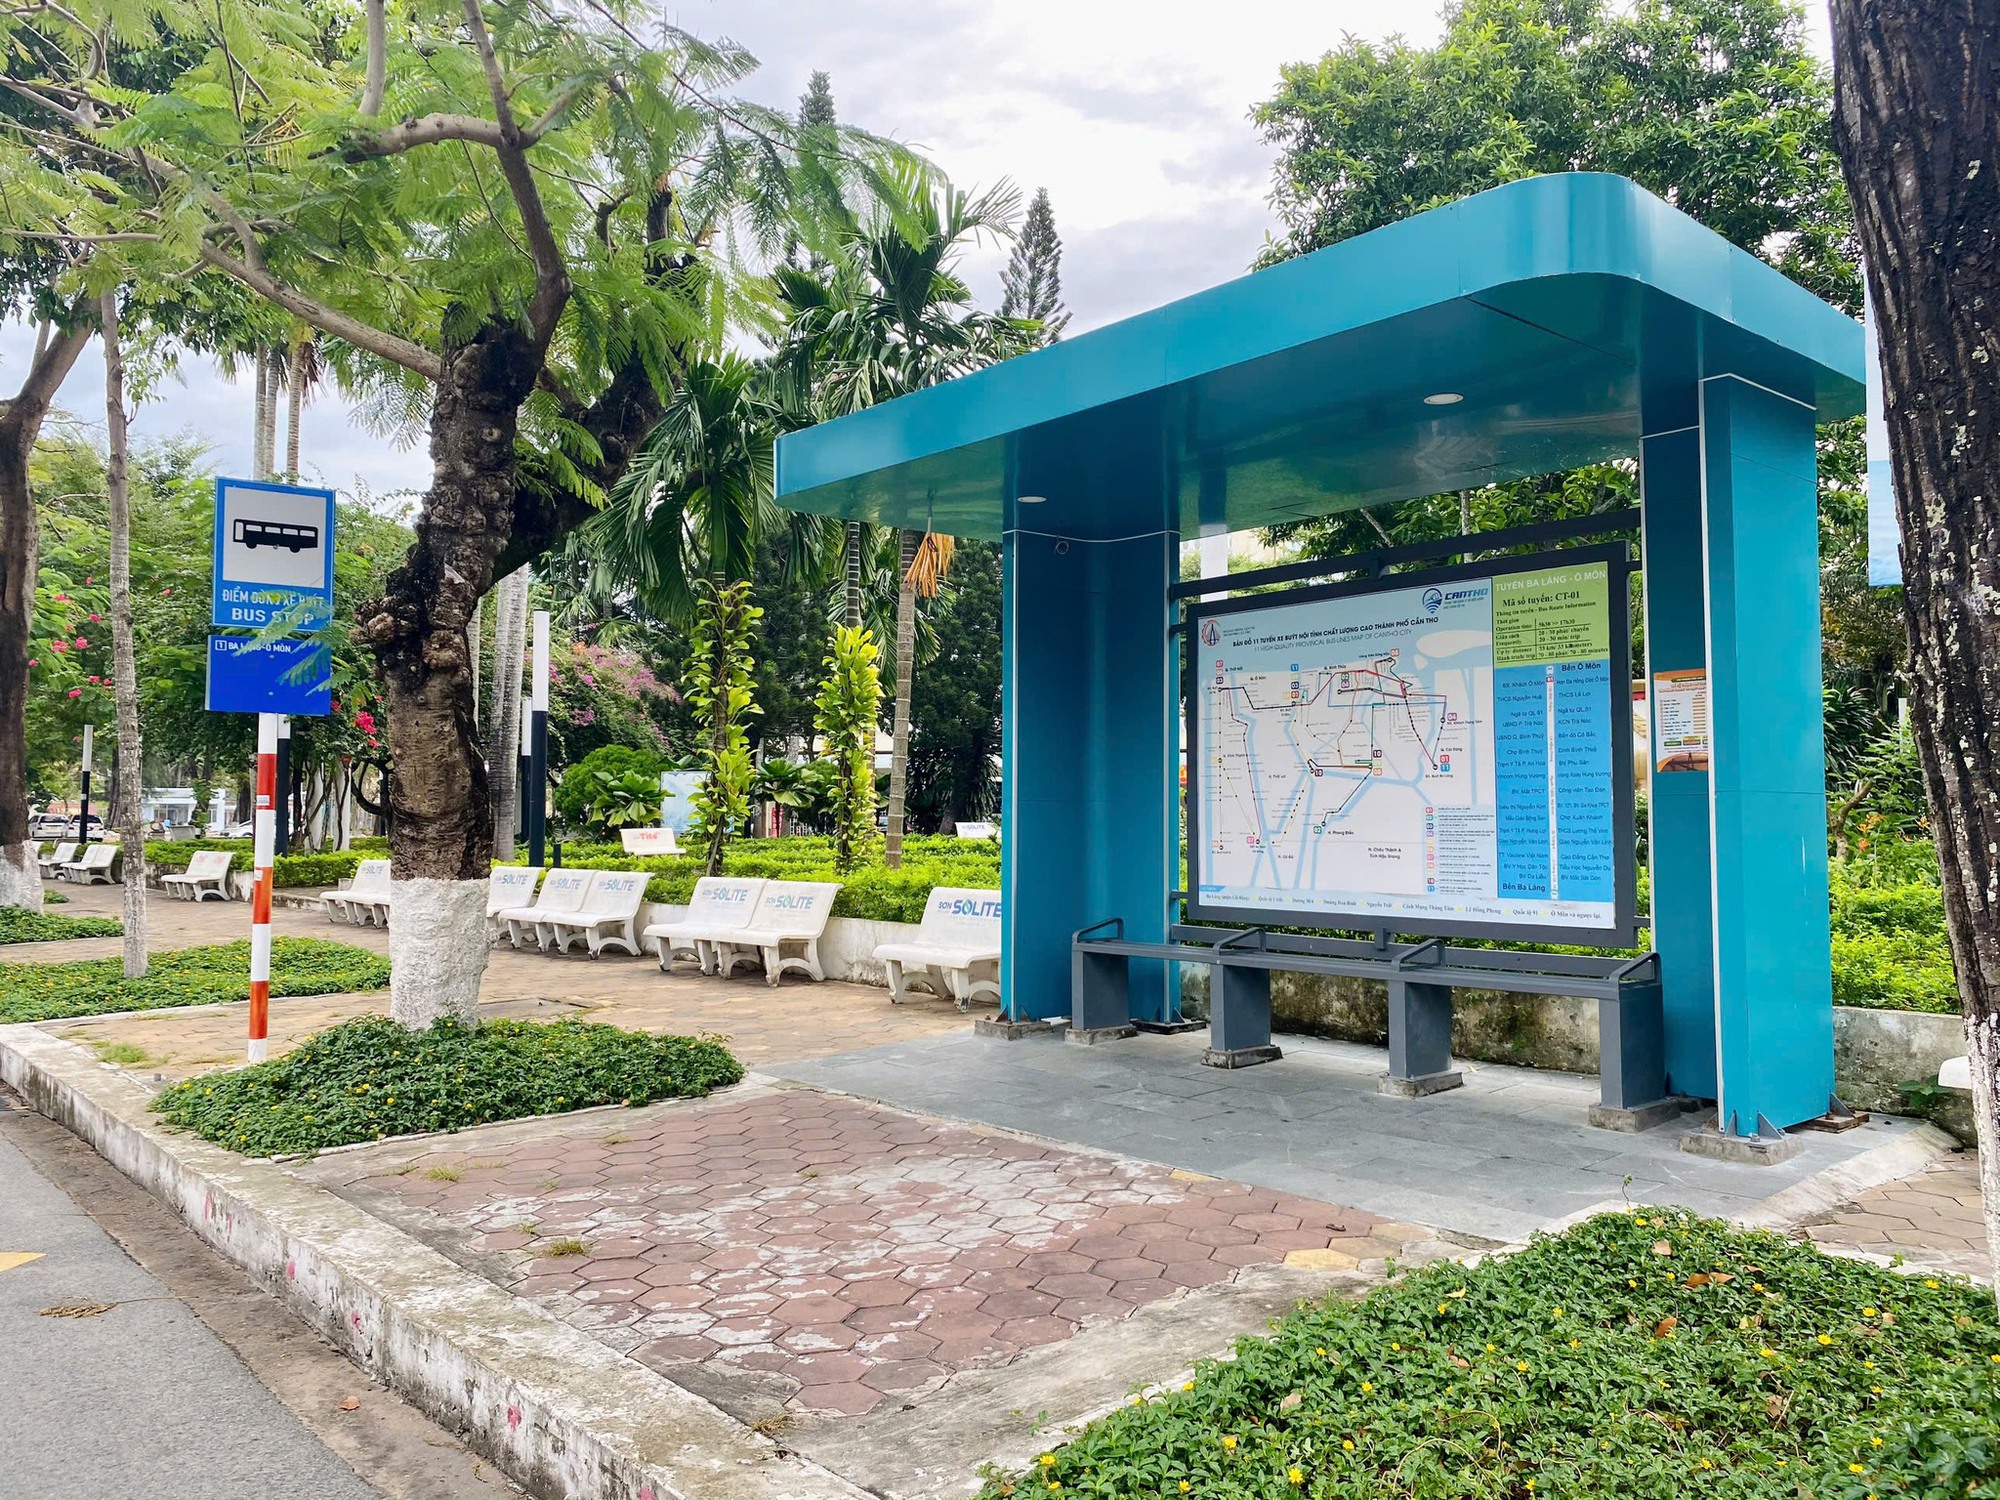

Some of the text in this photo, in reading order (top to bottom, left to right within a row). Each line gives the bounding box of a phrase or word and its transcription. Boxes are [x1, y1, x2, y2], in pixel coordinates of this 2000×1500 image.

[1526, 579, 1540, 588] BA
[1574, 571, 1582, 582] Ô
[1584, 569, 1606, 580] MÔN
[222, 586, 248, 602] ĐIỂM
[1445, 588, 1488, 600] CANTHO
[1502, 590, 1580, 608] Mã số tuyến: CT-01
[232, 608, 266, 622] BUS
[1396, 618, 1409, 628] PHỐ
[228, 642, 238, 650] BA
[273, 643, 291, 652] MÔN
[1562, 664, 1576, 672] Bến
[1586, 662, 1600, 670] Môn
[502, 874, 528, 886] SOLITE
[556, 878, 582, 890] SOLITE
[605, 878, 636, 892] SOLITE
[1502, 882, 1516, 890] Bến
[1518, 882, 1527, 890] Ba
[712, 886, 748, 902] SOLITE
[775, 894, 814, 910] SOLITE
[952, 898, 1002, 918] SOLITE
